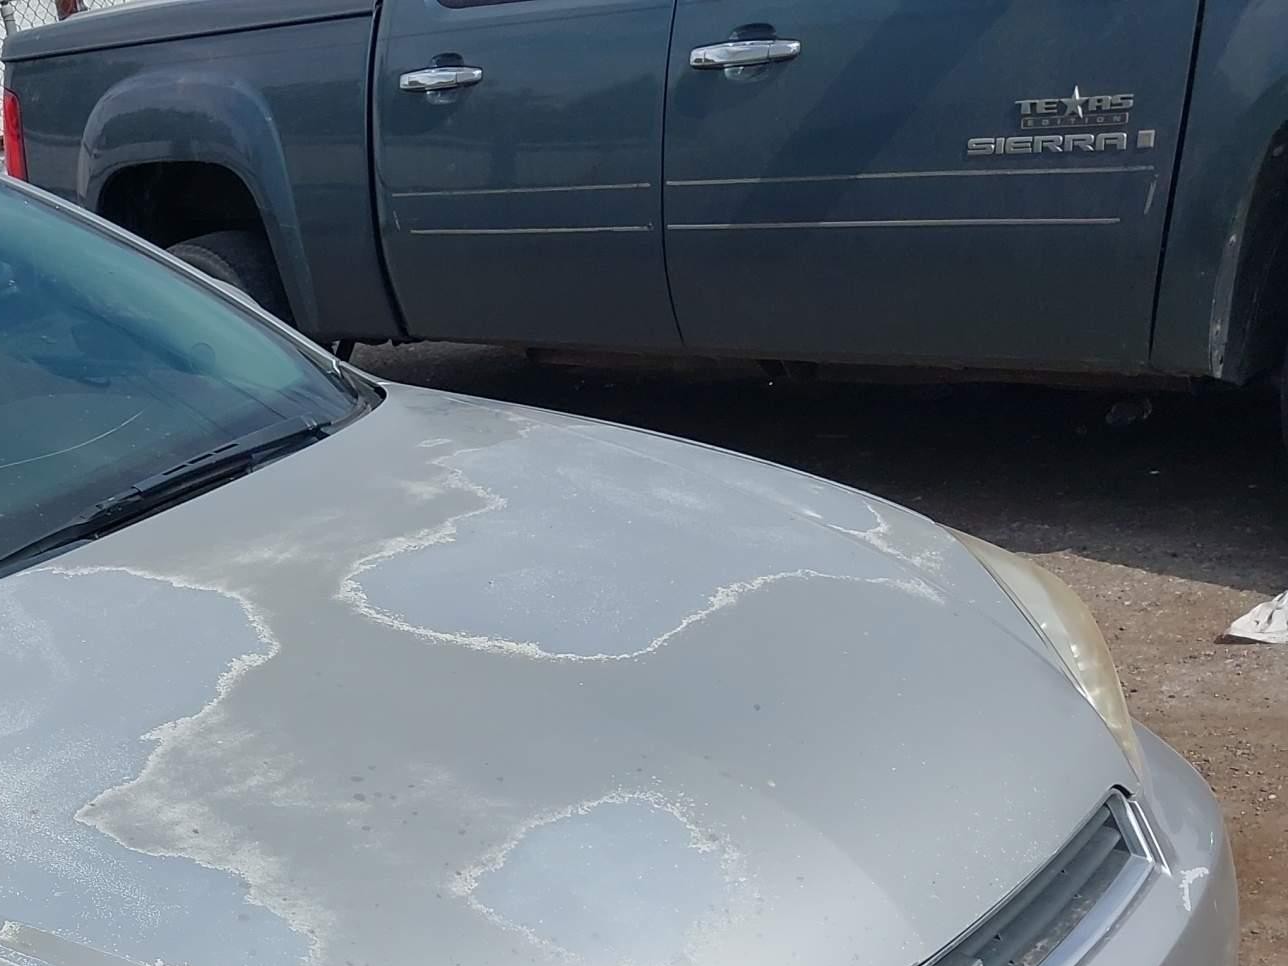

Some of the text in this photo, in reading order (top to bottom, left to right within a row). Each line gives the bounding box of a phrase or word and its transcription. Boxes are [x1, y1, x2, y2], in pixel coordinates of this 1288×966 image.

[1015, 86, 1134, 117] TEXAS
[1027, 114, 1122, 127] EDITION
[967, 132, 1128, 155] SIERRA
